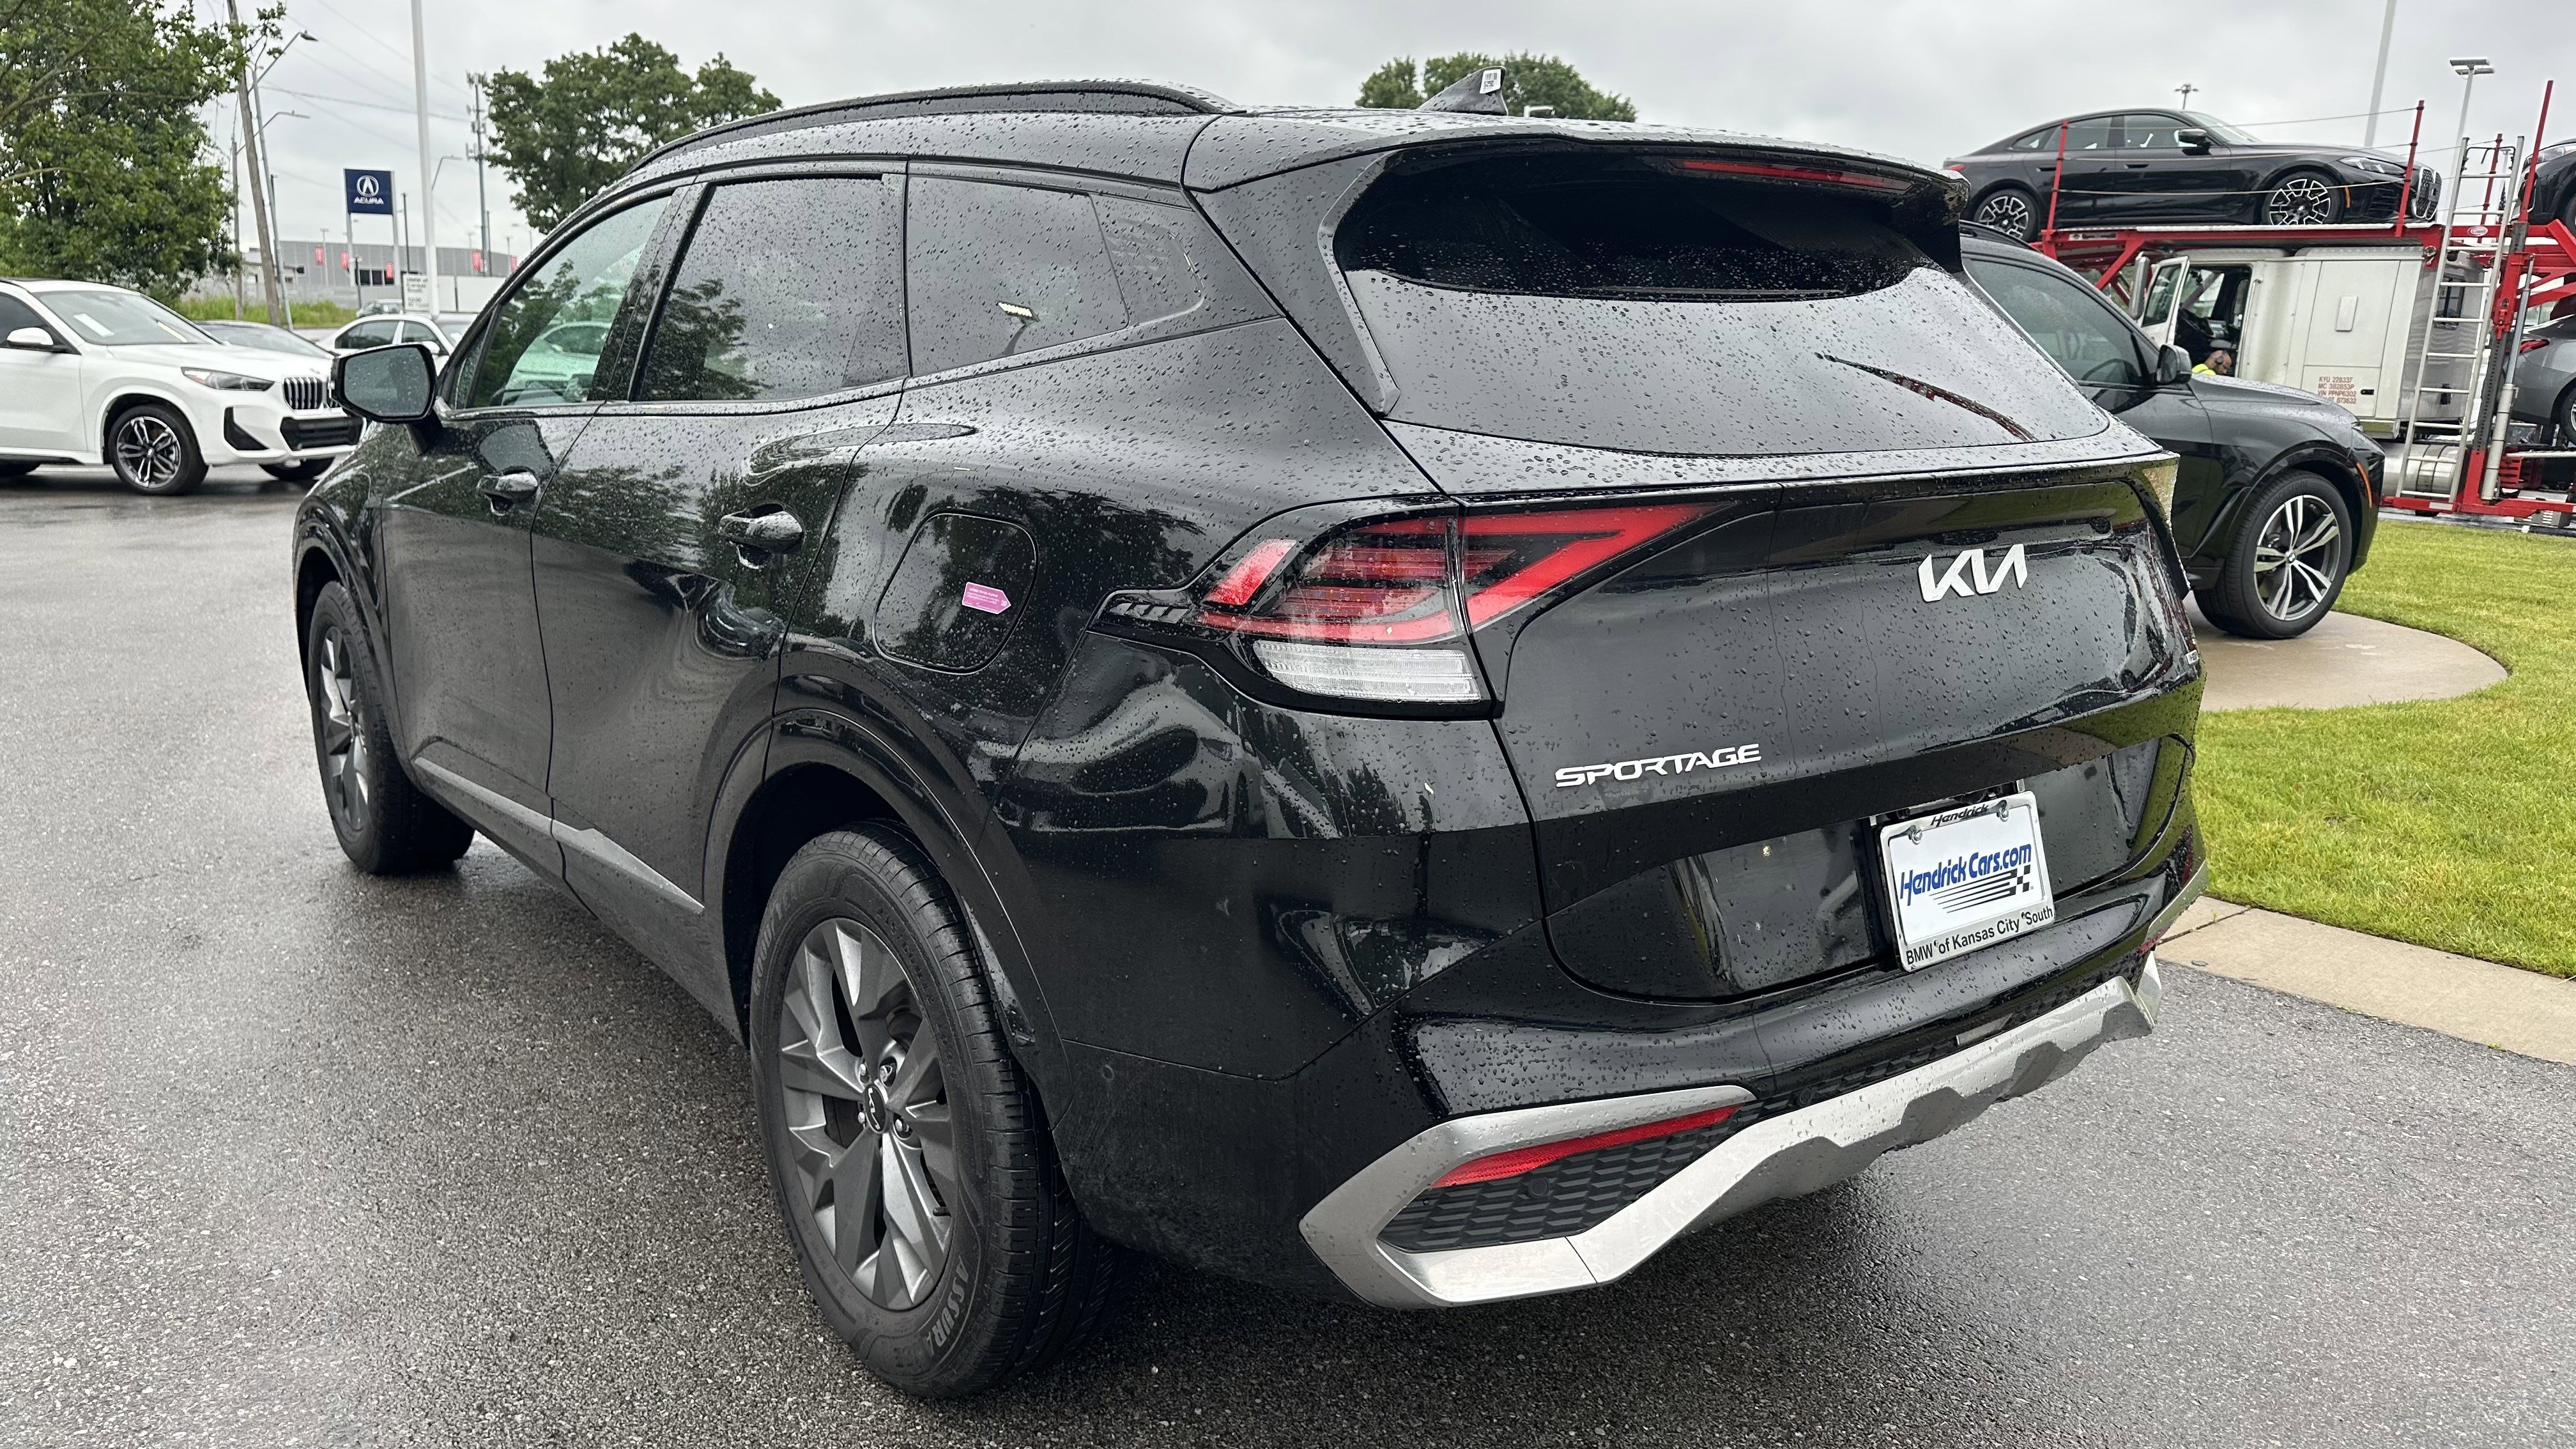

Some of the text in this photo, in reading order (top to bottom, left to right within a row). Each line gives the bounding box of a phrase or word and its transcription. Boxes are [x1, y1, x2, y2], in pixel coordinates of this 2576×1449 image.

[1918, 544, 2028, 602] KIA
[1555, 744, 1762, 787] SPORTAGE
[1930, 804, 1989, 827] Hendrick
[1906, 905, 2053, 965] BMW of Kansas City South
